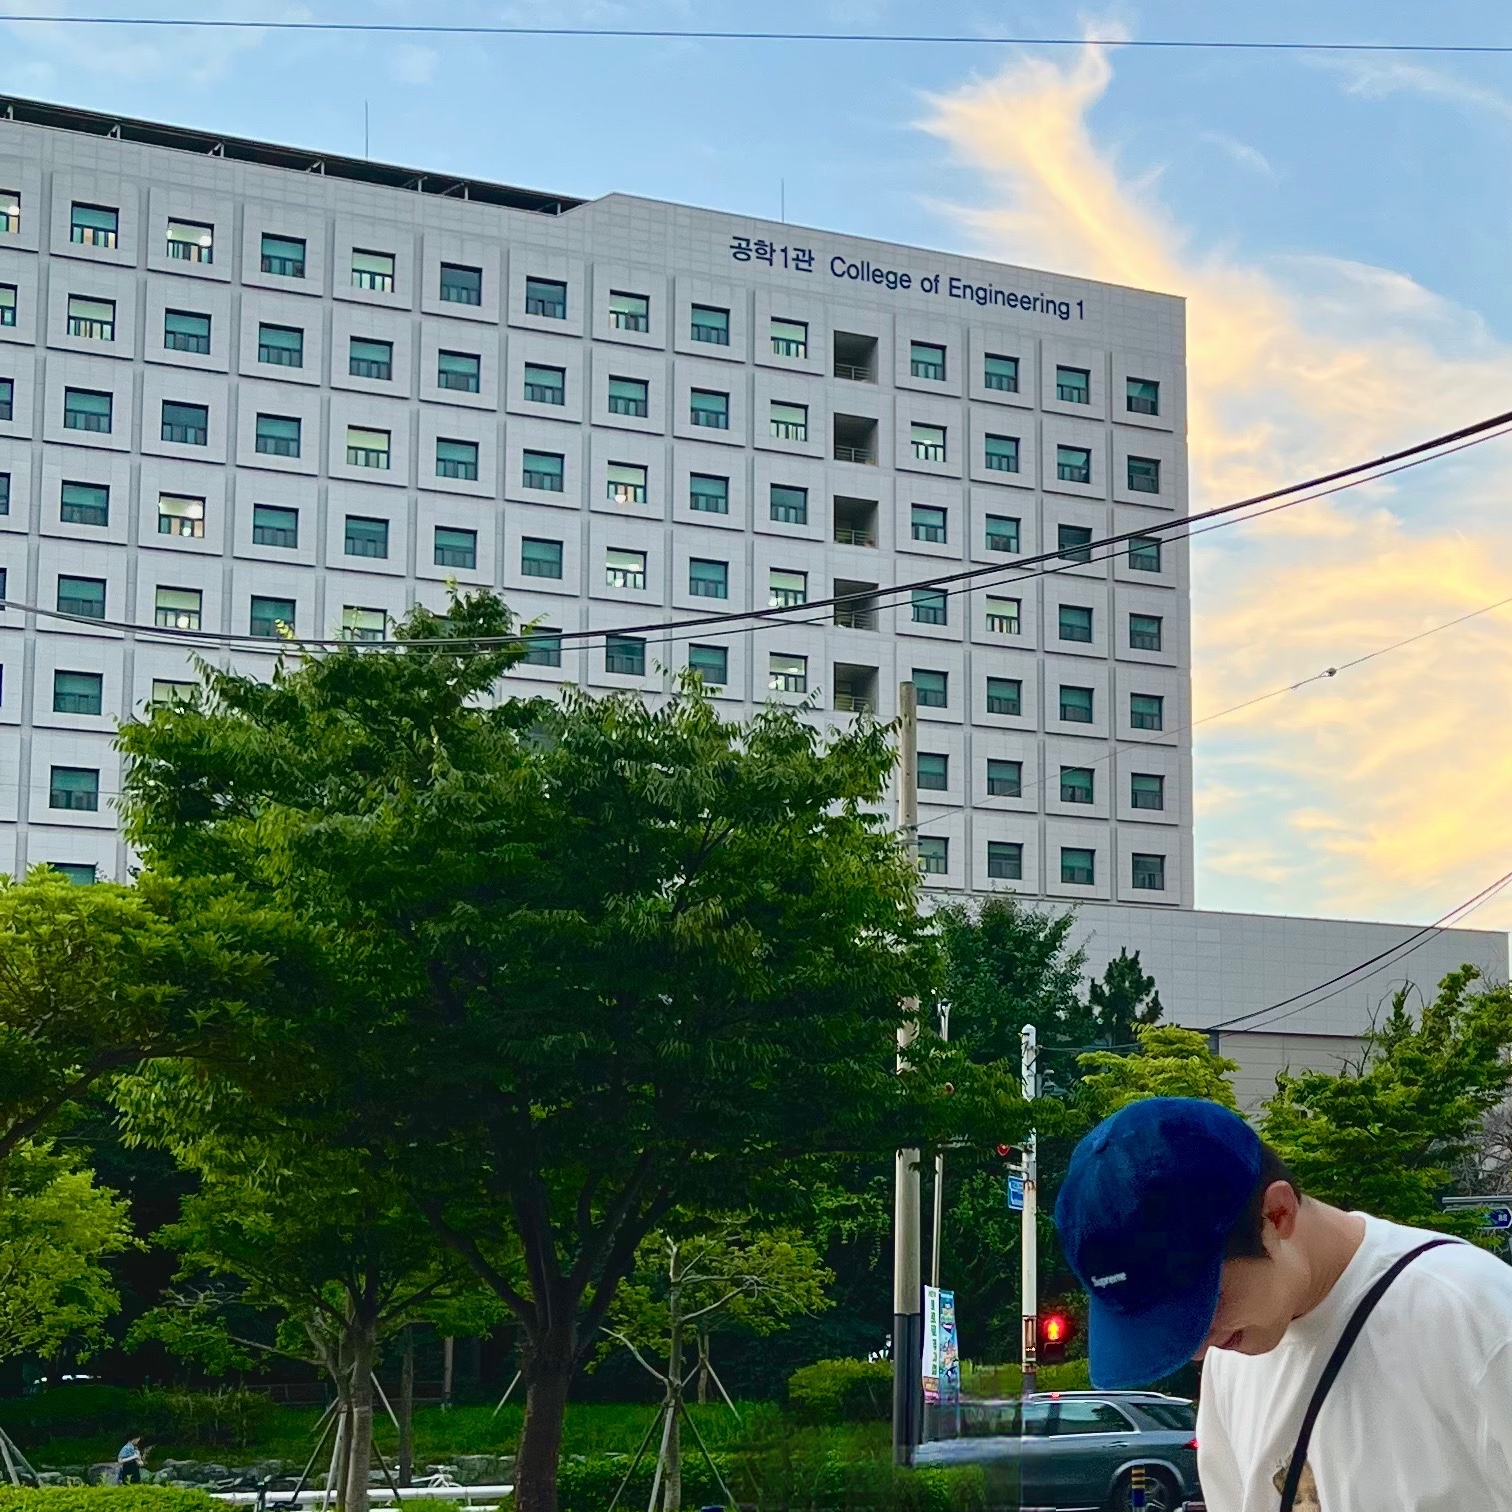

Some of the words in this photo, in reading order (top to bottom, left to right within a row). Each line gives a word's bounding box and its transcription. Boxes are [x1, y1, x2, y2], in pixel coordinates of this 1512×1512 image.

[729, 235, 815, 274] 공학1관
[829, 255, 913, 291] College
[919, 273, 941, 295] of
[948, 276, 1071, 321] Engineering
[1076, 299, 1085, 321] 1
